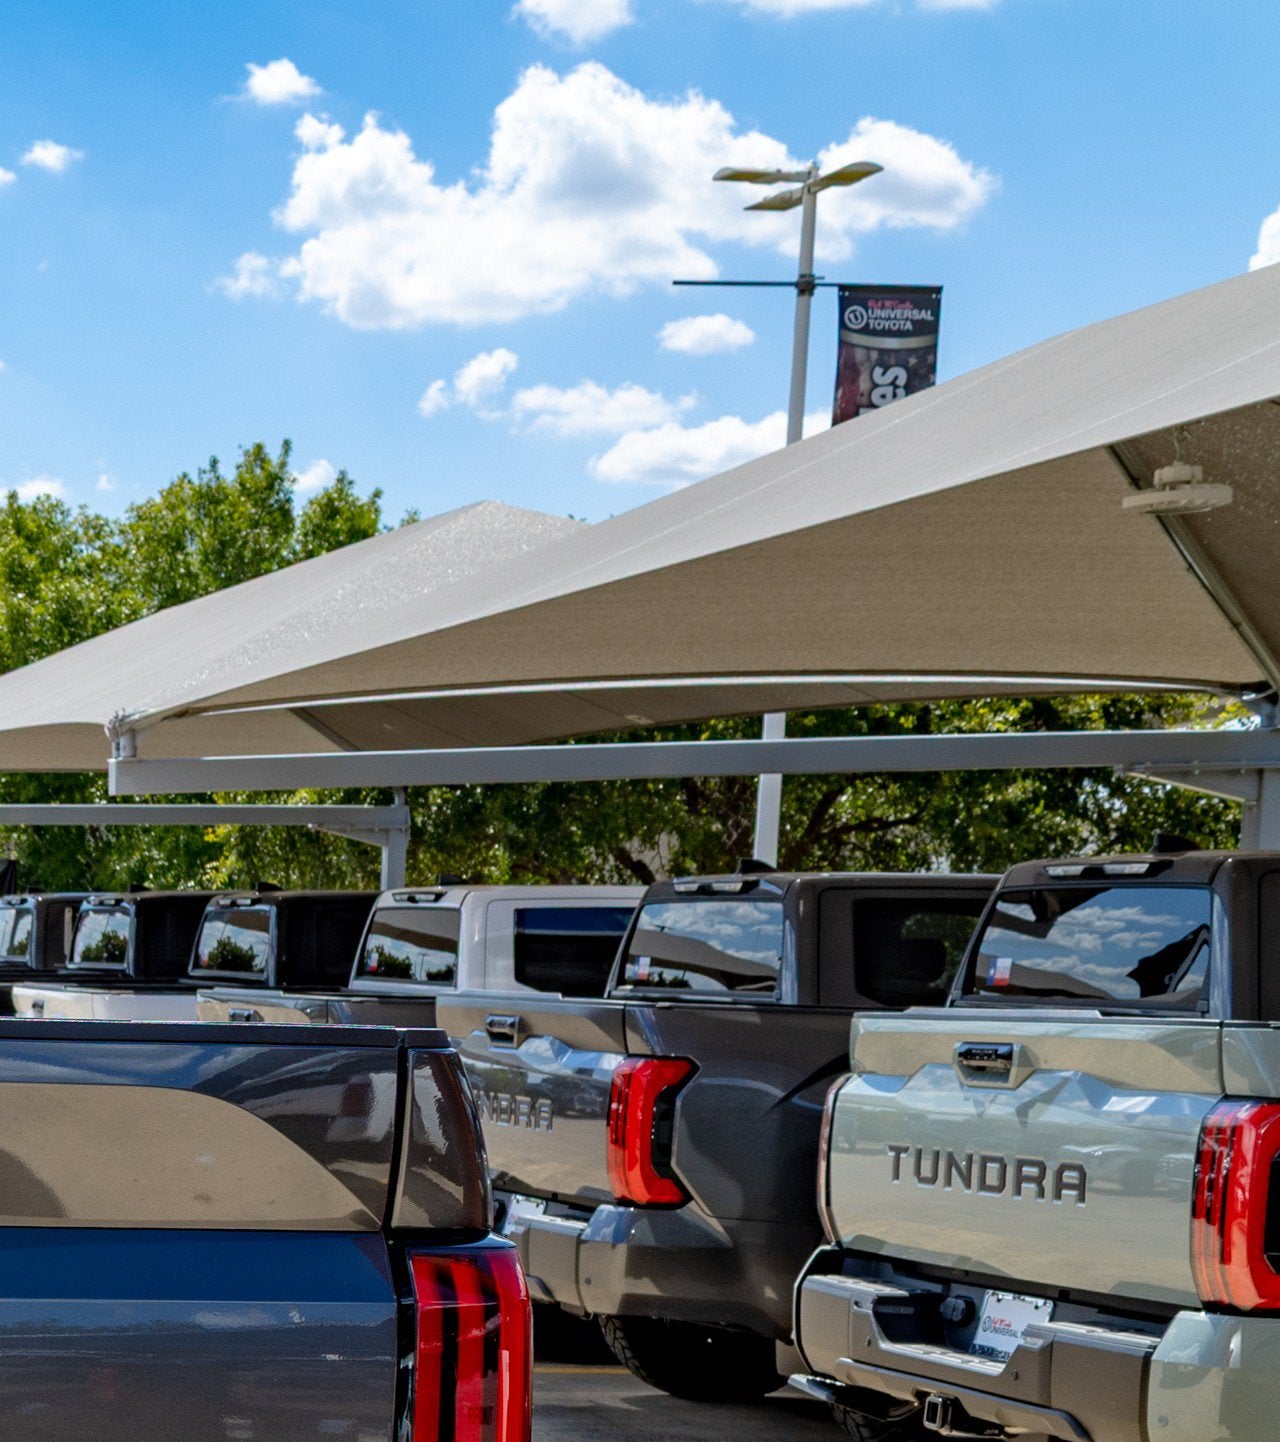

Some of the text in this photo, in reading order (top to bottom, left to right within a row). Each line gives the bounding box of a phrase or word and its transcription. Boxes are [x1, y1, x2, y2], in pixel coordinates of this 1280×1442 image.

[868, 308, 934, 321] UNIVERSAL
[869, 320, 913, 331] TOYOTA
[474, 1090, 553, 1132] NDRA
[886, 1143, 1087, 1208] TUNDRA
[989, 1326, 1020, 1339] UNIVERSAL
